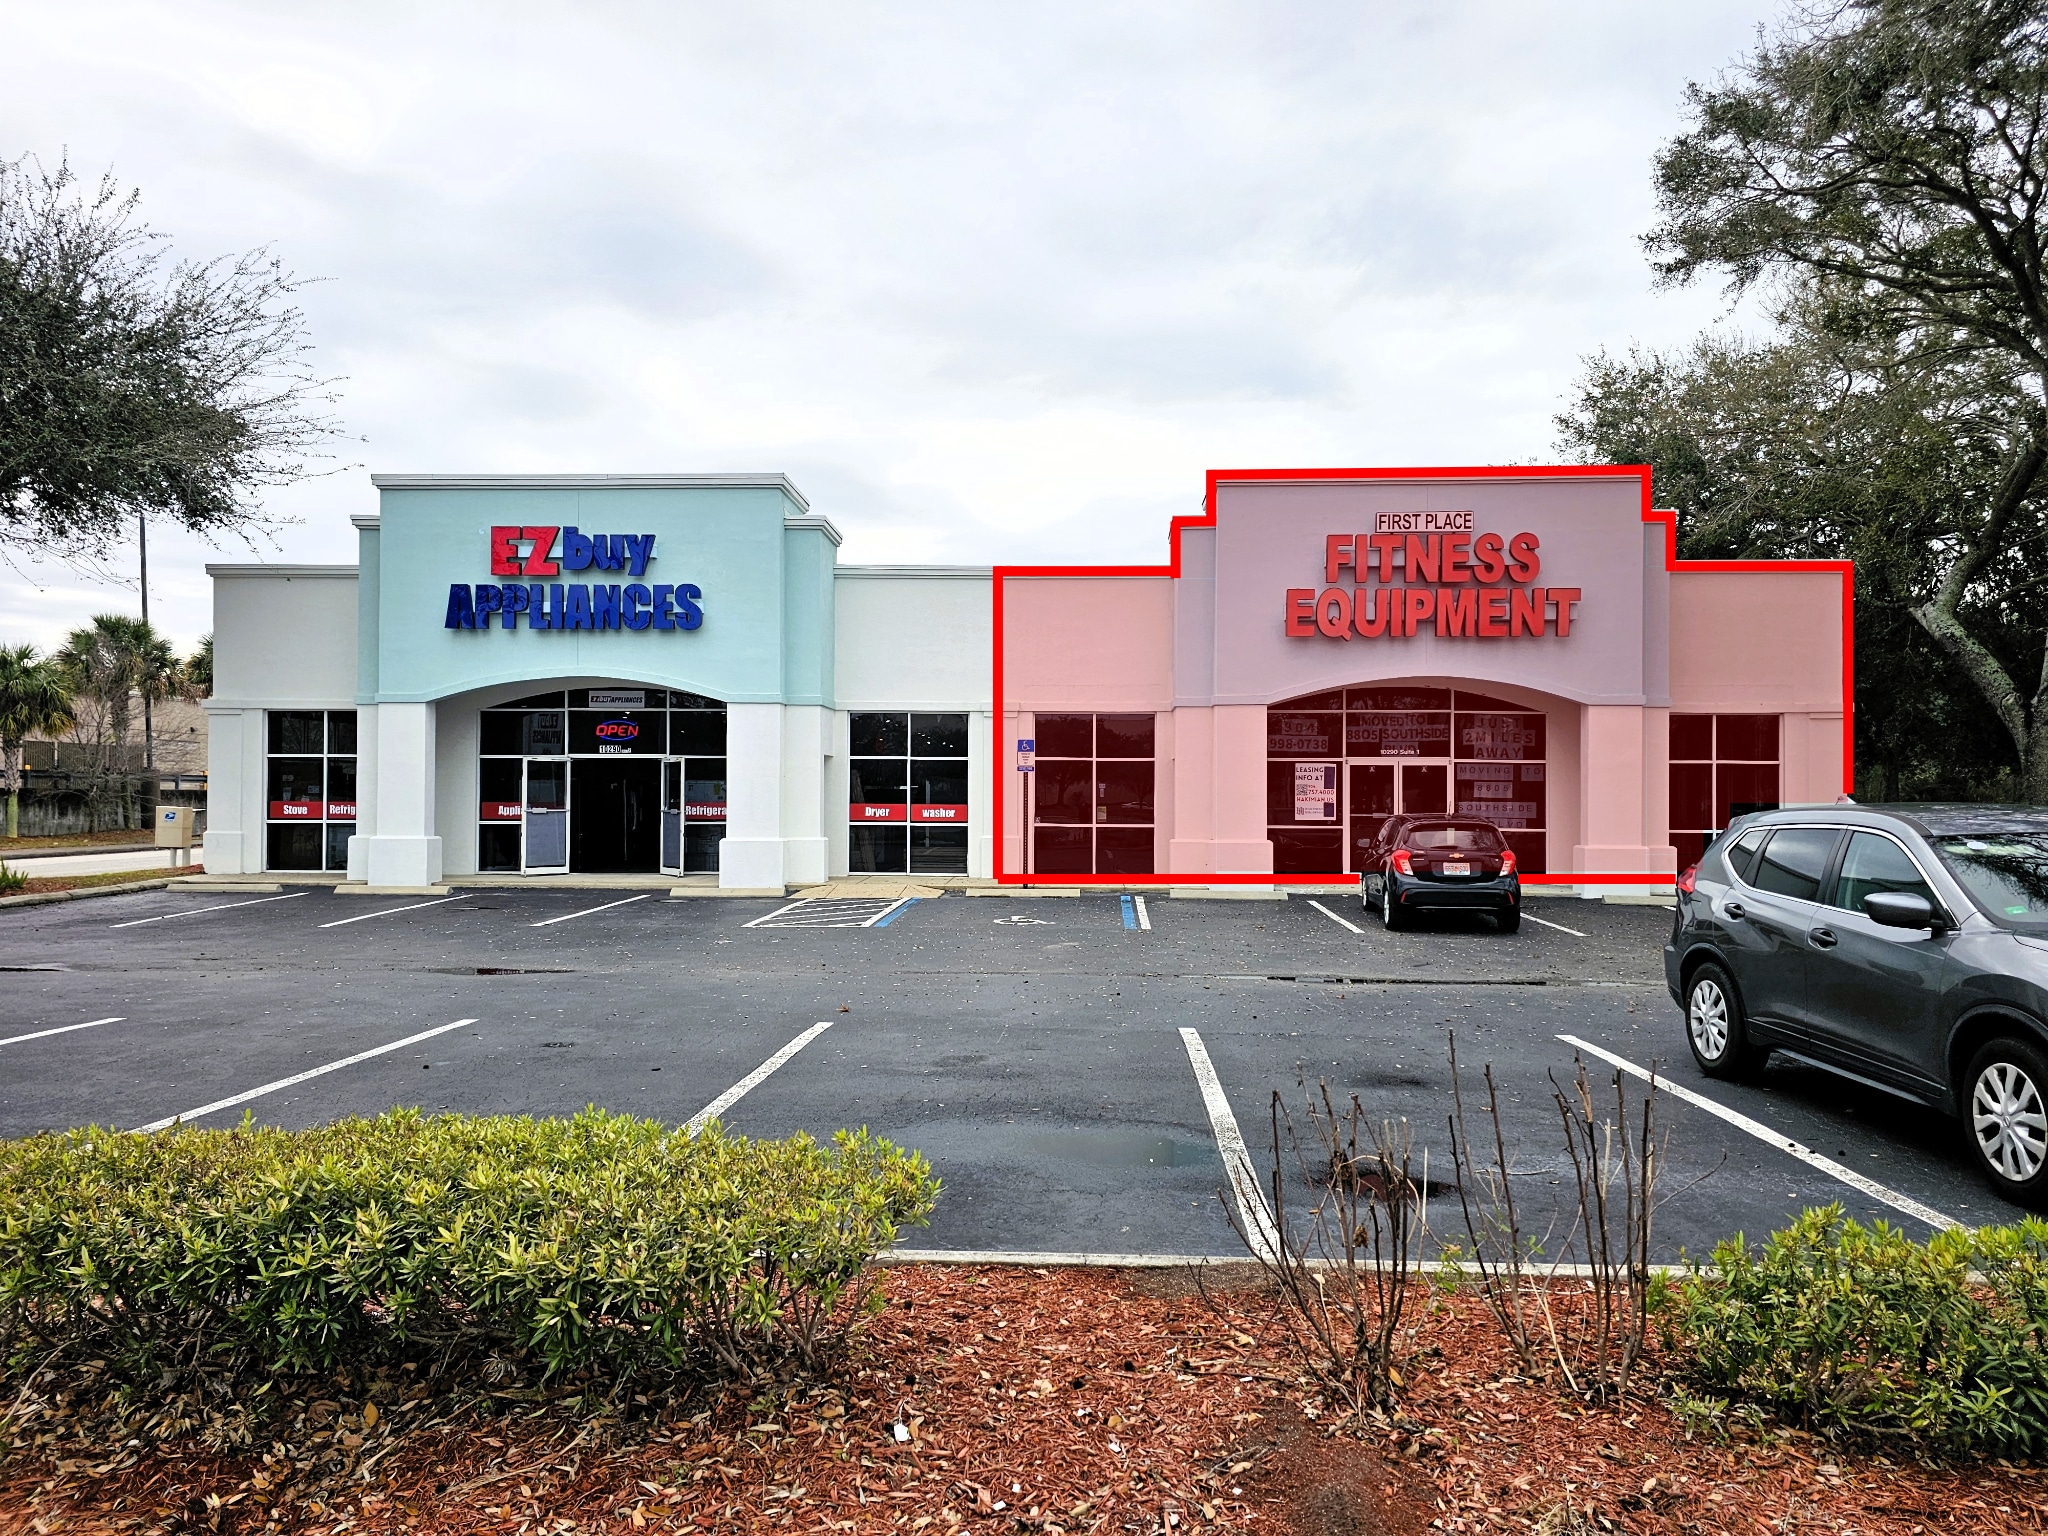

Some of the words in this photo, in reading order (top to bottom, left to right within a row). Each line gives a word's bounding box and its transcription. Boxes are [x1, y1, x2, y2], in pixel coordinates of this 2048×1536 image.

[1378, 514, 1422, 531] FIRST
[1425, 513, 1473, 530] PLACE
[1325, 532, 1541, 584] FITNESS
[444, 583, 705, 631] APPLIANCES
[1285, 587, 1582, 641] EQUIPMENT
[1361, 715, 1404, 727] MOVED
[1408, 714, 1426, 725] TO
[595, 724, 639, 737] OPEN
[1346, 729, 1378, 740] 8805
[1383, 727, 1449, 740] SOUTHSIDE
[600, 744, 621, 754] 10290
[1269, 738, 1328, 750] 998-0738
[1476, 747, 1521, 758] AWAY
[1460, 766, 1511, 774] MOVING
[1525, 767, 1541, 775] TO
[283, 804, 308, 815] Stove
[865, 806, 890, 818] Dryer
[922, 808, 956, 818] washer
[1459, 804, 1532, 812] SOUTHSIDE
